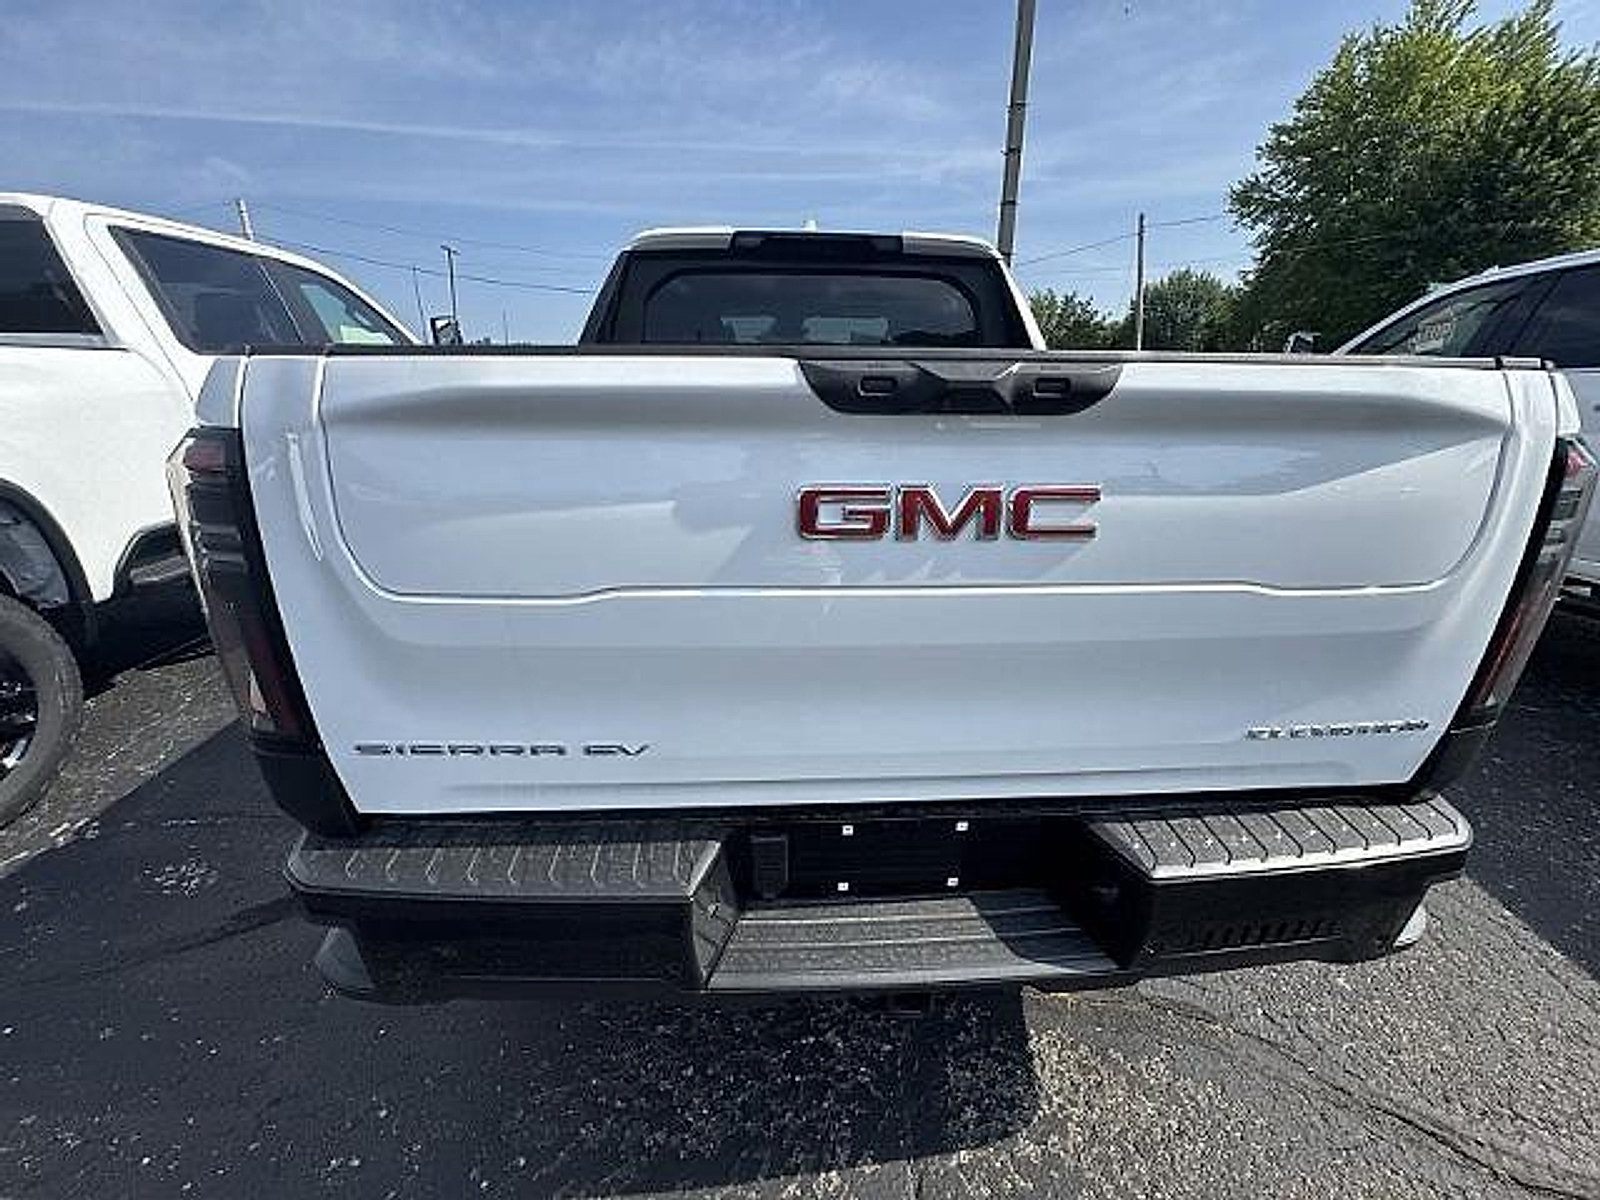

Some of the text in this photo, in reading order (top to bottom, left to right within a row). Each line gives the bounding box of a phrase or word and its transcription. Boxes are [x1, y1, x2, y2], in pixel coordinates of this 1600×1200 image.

[797, 483, 1102, 541] GMC
[353, 743, 650, 757] SIERRA EV
